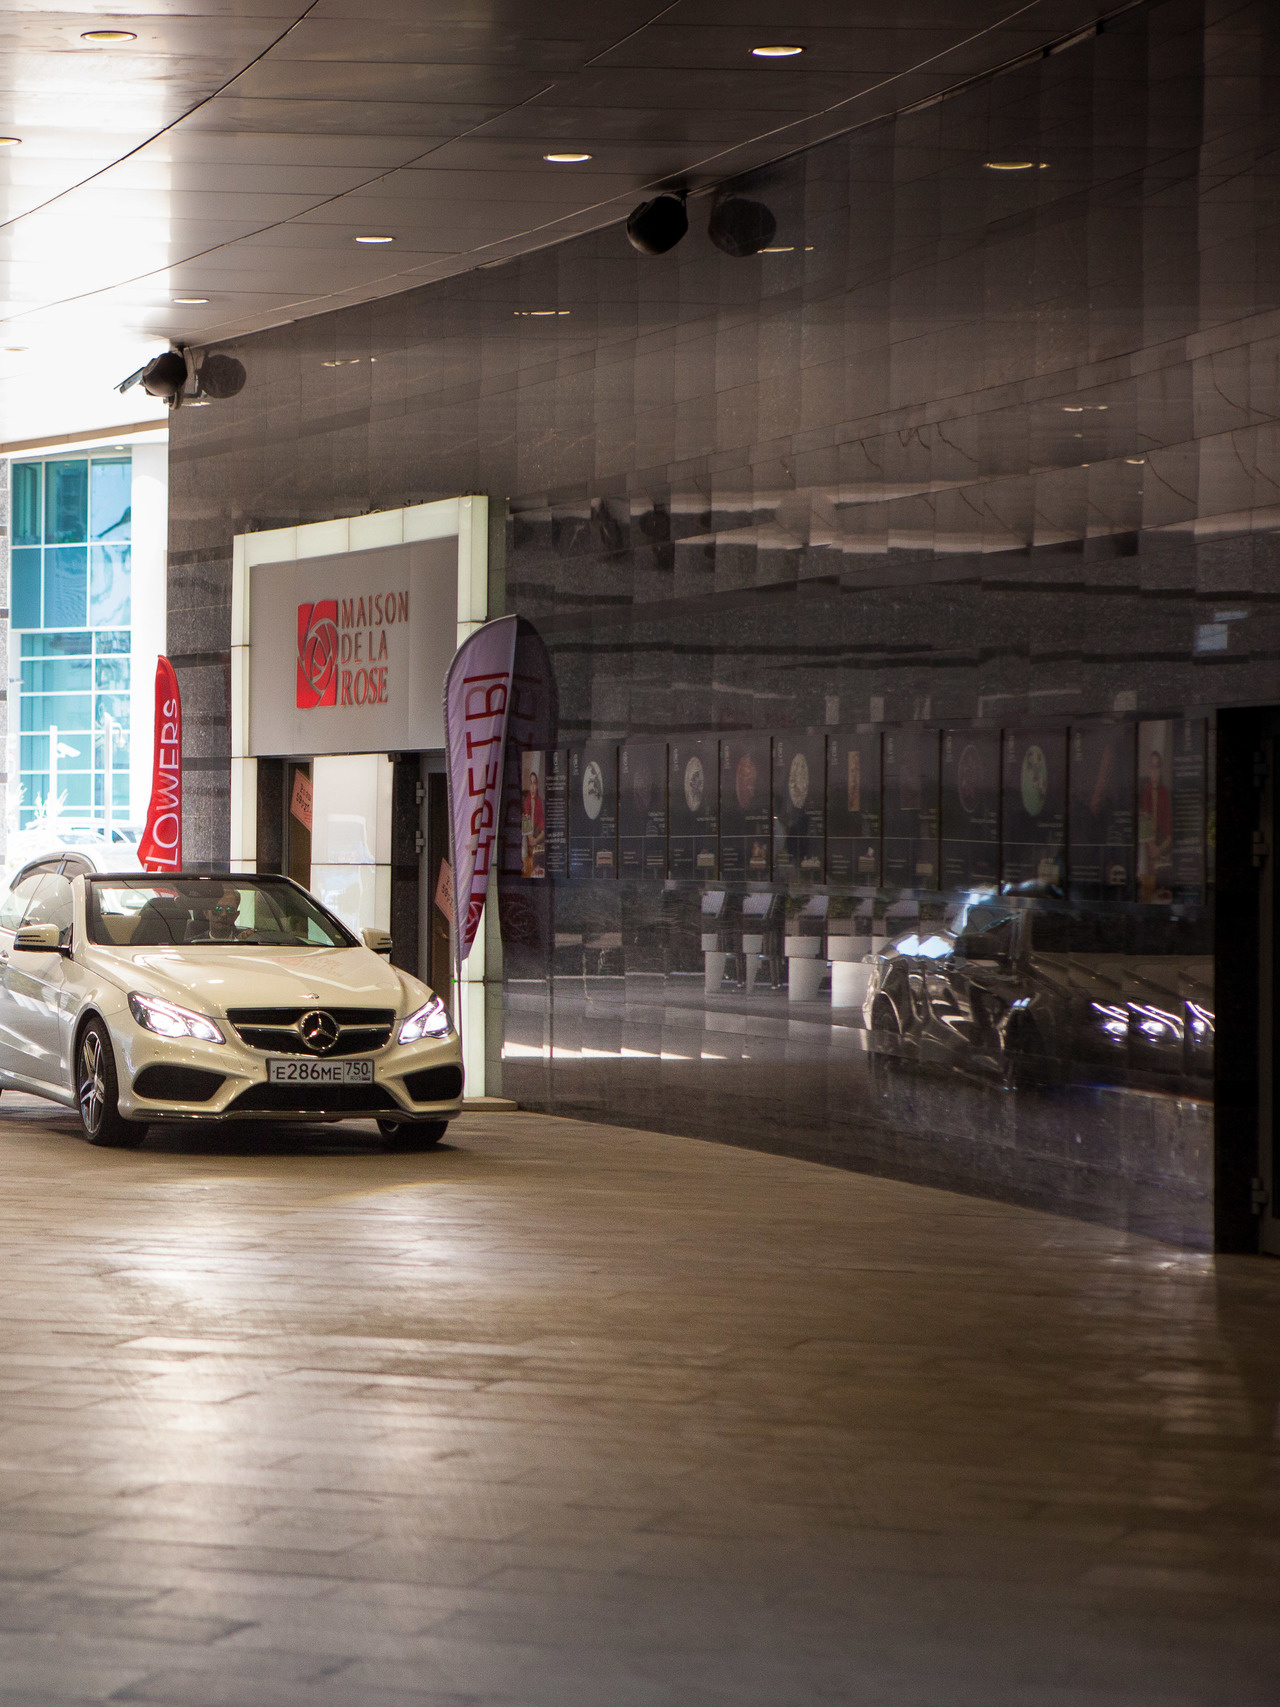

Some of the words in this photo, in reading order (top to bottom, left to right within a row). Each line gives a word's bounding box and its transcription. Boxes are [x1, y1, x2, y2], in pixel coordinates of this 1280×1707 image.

[341, 591, 408, 629] MAISON
[341, 632, 362, 664] DE
[368, 630, 388, 661] LA
[340, 667, 388, 706] ROSE
[276, 1063, 342, 1080] E286ME
[346, 1062, 369, 1075] 750
